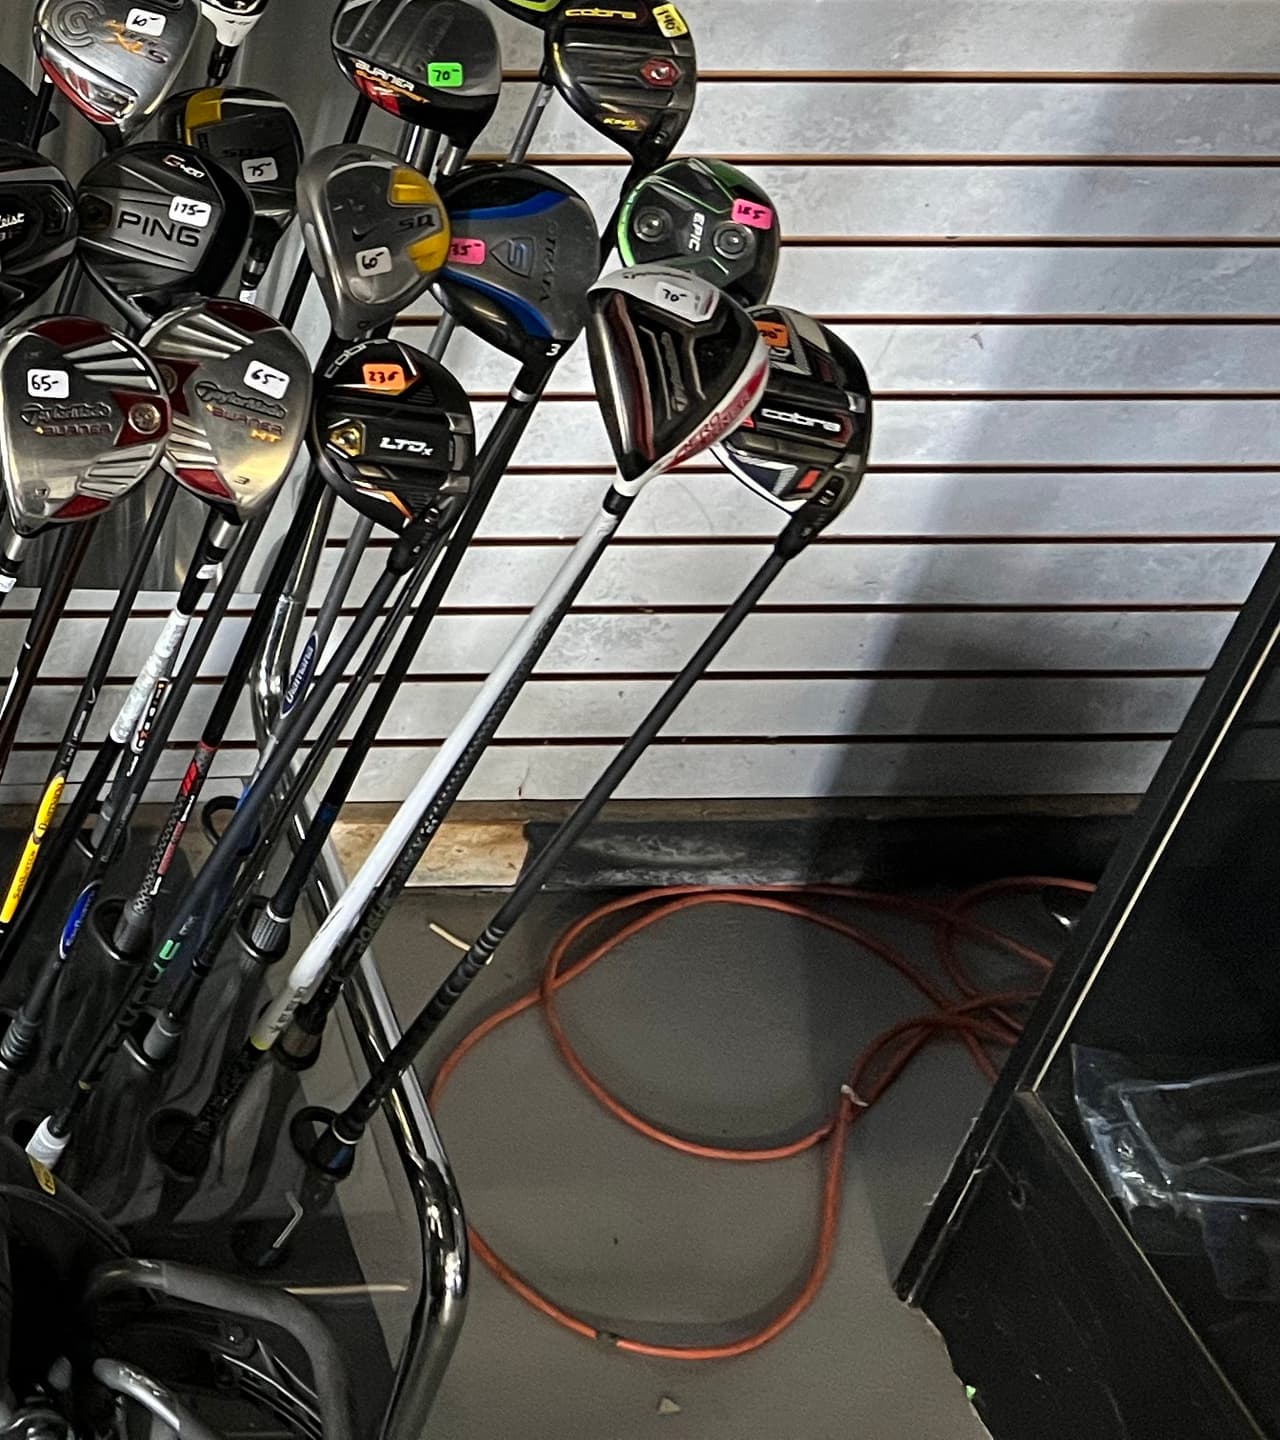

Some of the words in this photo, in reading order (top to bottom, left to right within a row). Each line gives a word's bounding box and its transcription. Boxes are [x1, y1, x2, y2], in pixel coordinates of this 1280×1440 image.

[564, 7, 638, 21] cobra
[354, 60, 416, 92] BURNER
[431, 68, 461, 83] 70-
[162, 154, 206, 179] G400
[116, 210, 201, 248] PING
[396, 213, 437, 230] SQ
[688, 212, 706, 253] EPIC
[662, 288, 689, 302] 70-
[545, 343, 562, 357] 3
[212, 406, 284, 435] BURNER
[760, 408, 842, 434] cobra
[43, 423, 113, 438] BURNER
[249, 428, 282, 444] HT
